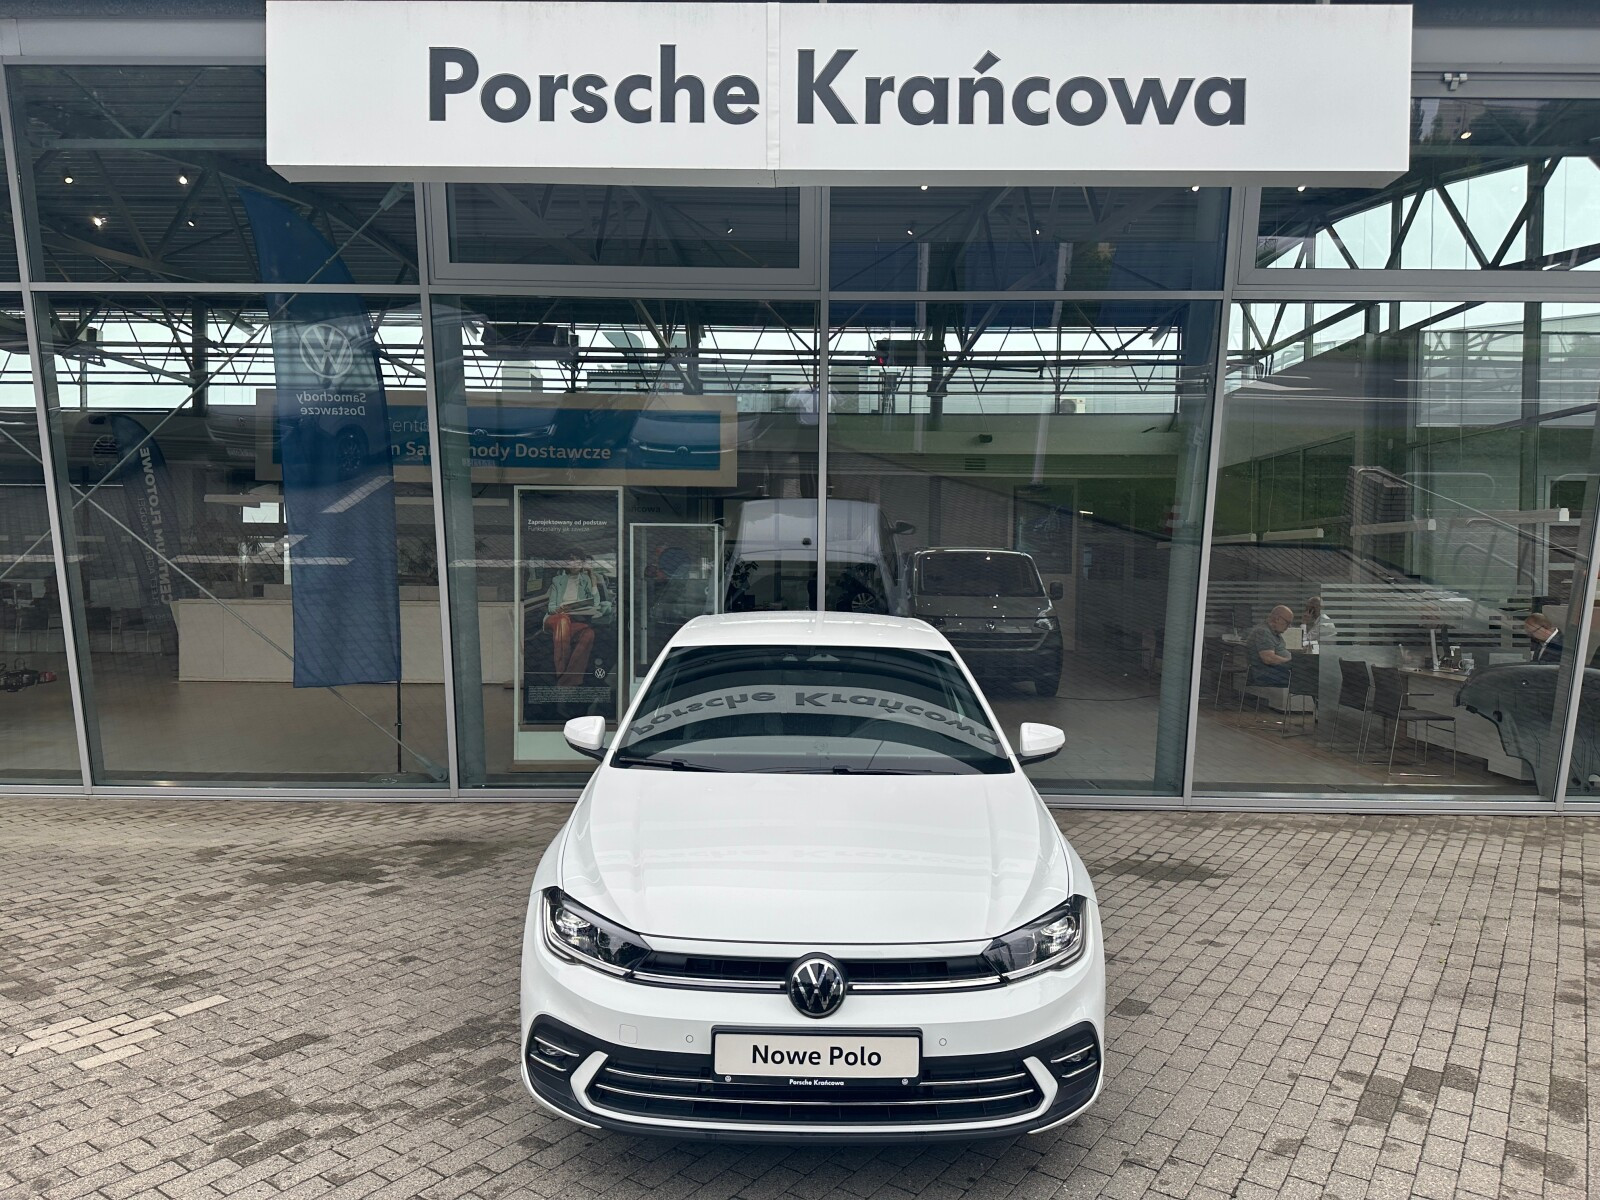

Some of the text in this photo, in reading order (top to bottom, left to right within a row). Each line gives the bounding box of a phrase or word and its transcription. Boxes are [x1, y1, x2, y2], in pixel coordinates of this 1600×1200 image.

[429, 44, 1247, 126] Porsche Krańcowa
[515, 443, 611, 459] Dostawcze
[752, 1044, 882, 1066] Nowe Polo
[789, 1078, 812, 1086] Porsche
